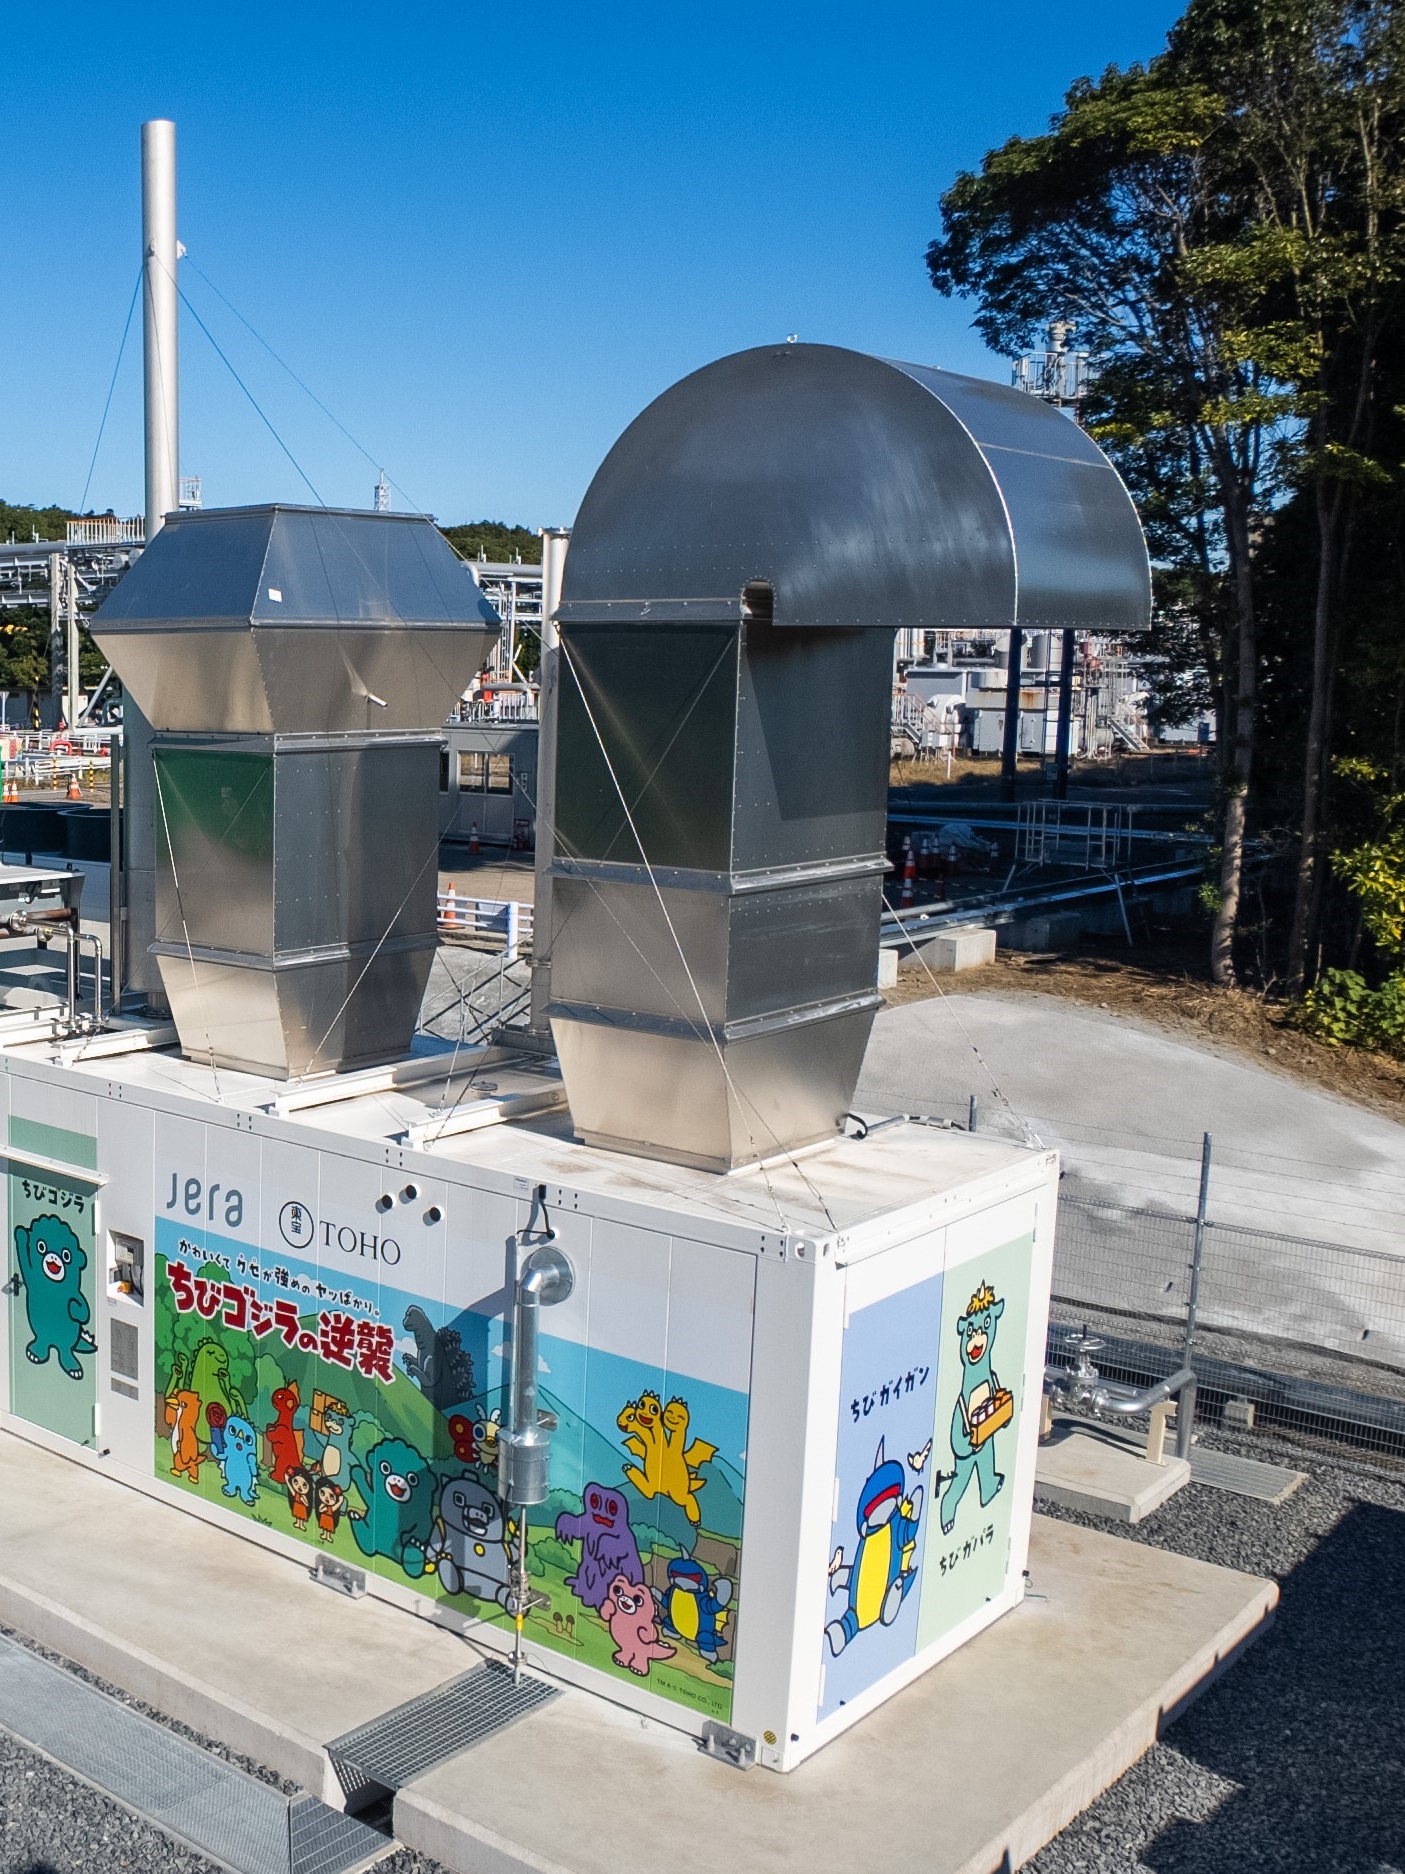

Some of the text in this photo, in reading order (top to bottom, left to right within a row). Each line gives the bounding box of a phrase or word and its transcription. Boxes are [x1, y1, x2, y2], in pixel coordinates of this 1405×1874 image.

[21, 1179, 85, 1214] ちびゴジラ
[179, 1239, 231, 1269] かわいくて
[319, 1220, 401, 1266] TOHO
[168, 1262, 395, 1384] ちびゴジラの逆襲
[850, 1366, 930, 1424] ちびガイガン
